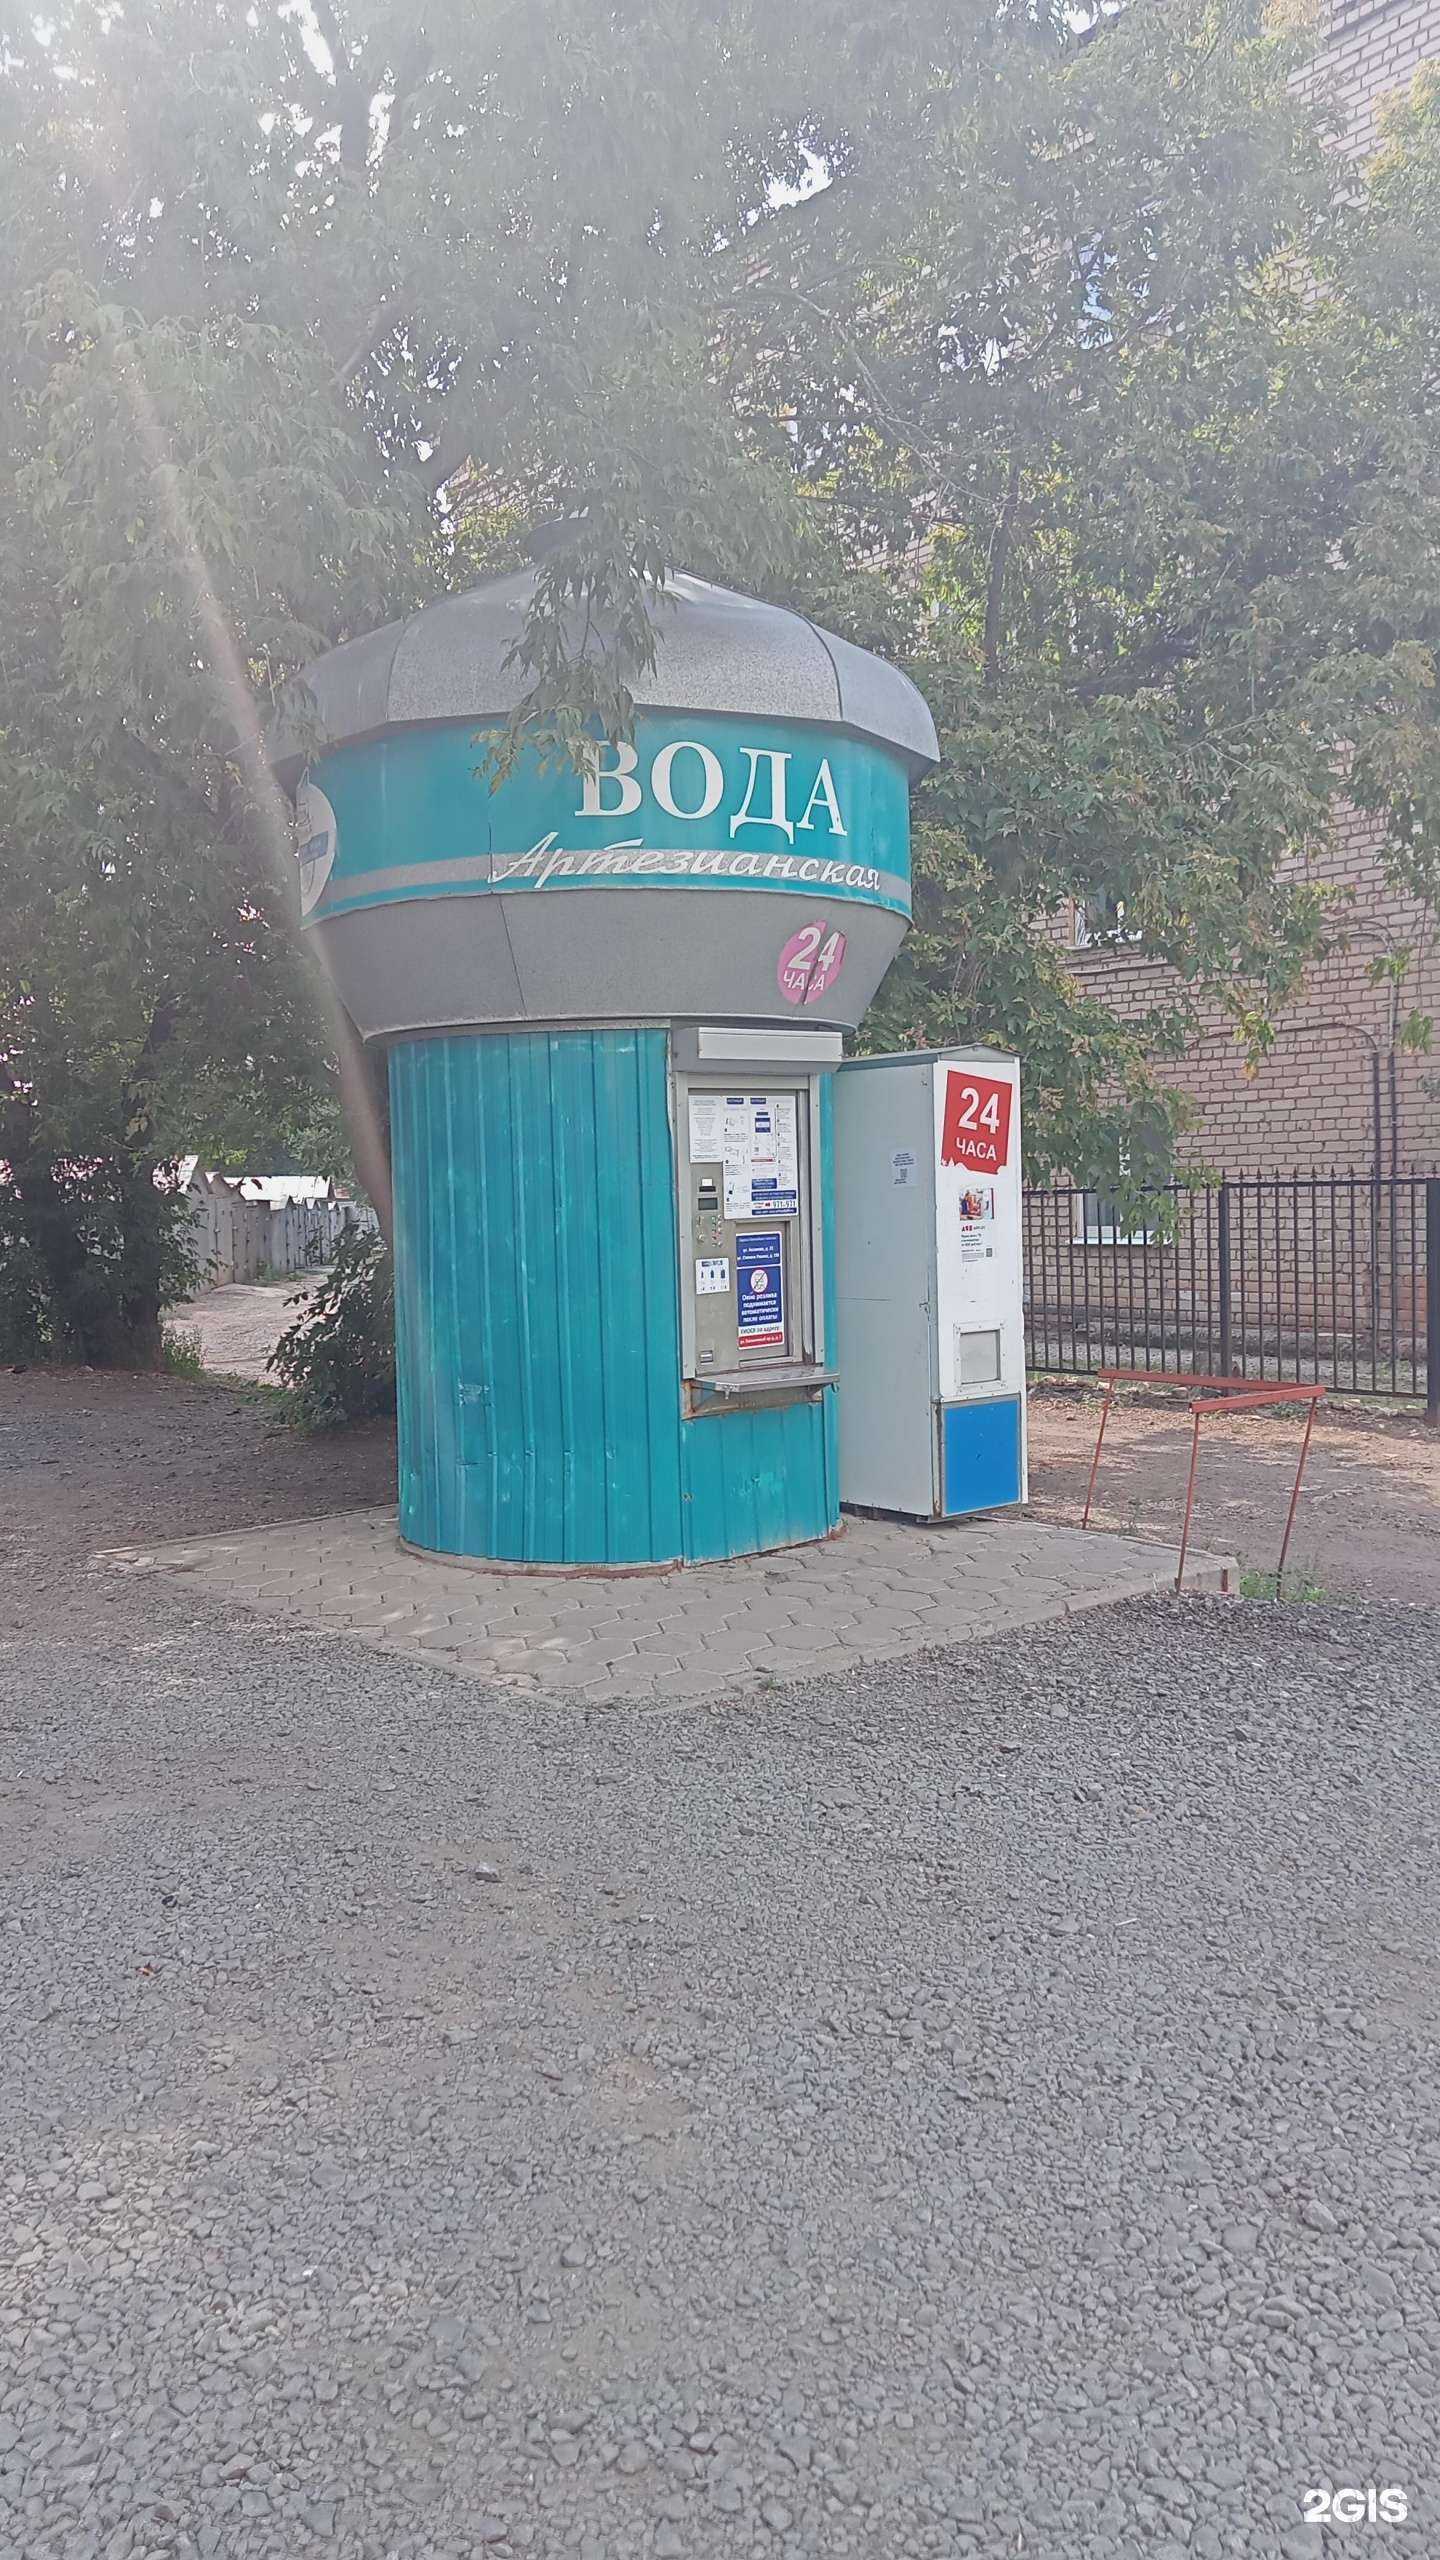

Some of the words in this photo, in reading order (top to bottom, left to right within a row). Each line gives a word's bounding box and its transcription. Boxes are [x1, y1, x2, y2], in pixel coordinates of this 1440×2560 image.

[575, 740, 847, 845] ВОДА
[487, 831, 881, 889] Артезианская
[788, 927, 840, 971] 24
[958, 1087, 1000, 1135] 24
[956, 1137, 997, 1161] ЧАСА
